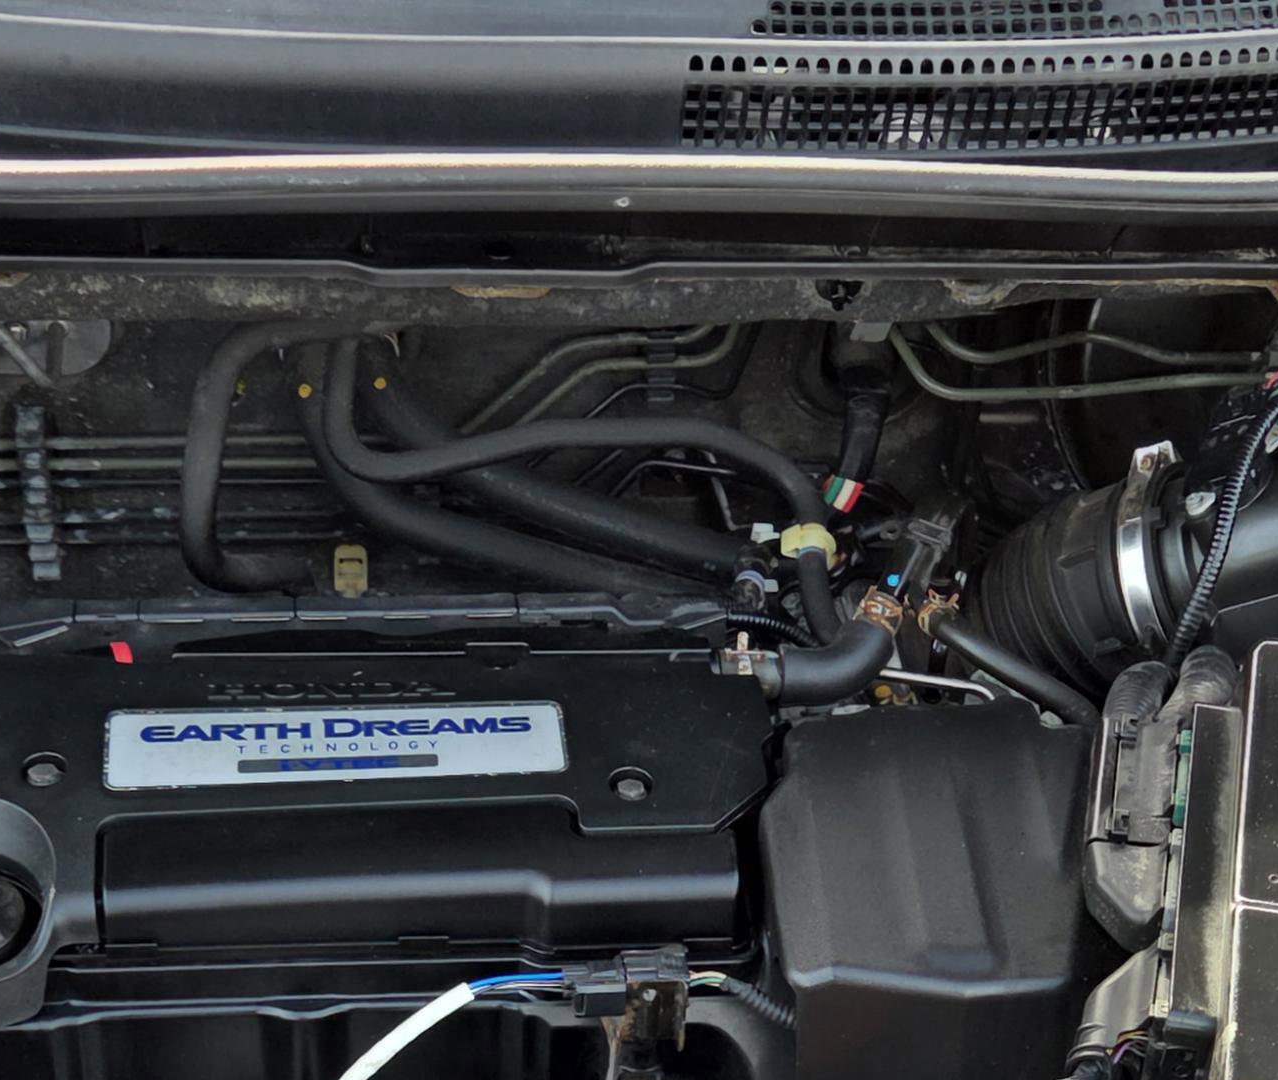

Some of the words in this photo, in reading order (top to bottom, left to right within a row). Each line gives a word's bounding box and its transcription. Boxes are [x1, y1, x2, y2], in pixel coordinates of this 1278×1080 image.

[207, 682, 457, 700] HONDA
[140, 721, 312, 743] EARTH
[323, 716, 532, 738] DREAMS
[238, 740, 439, 755] TECHNOLOGY
